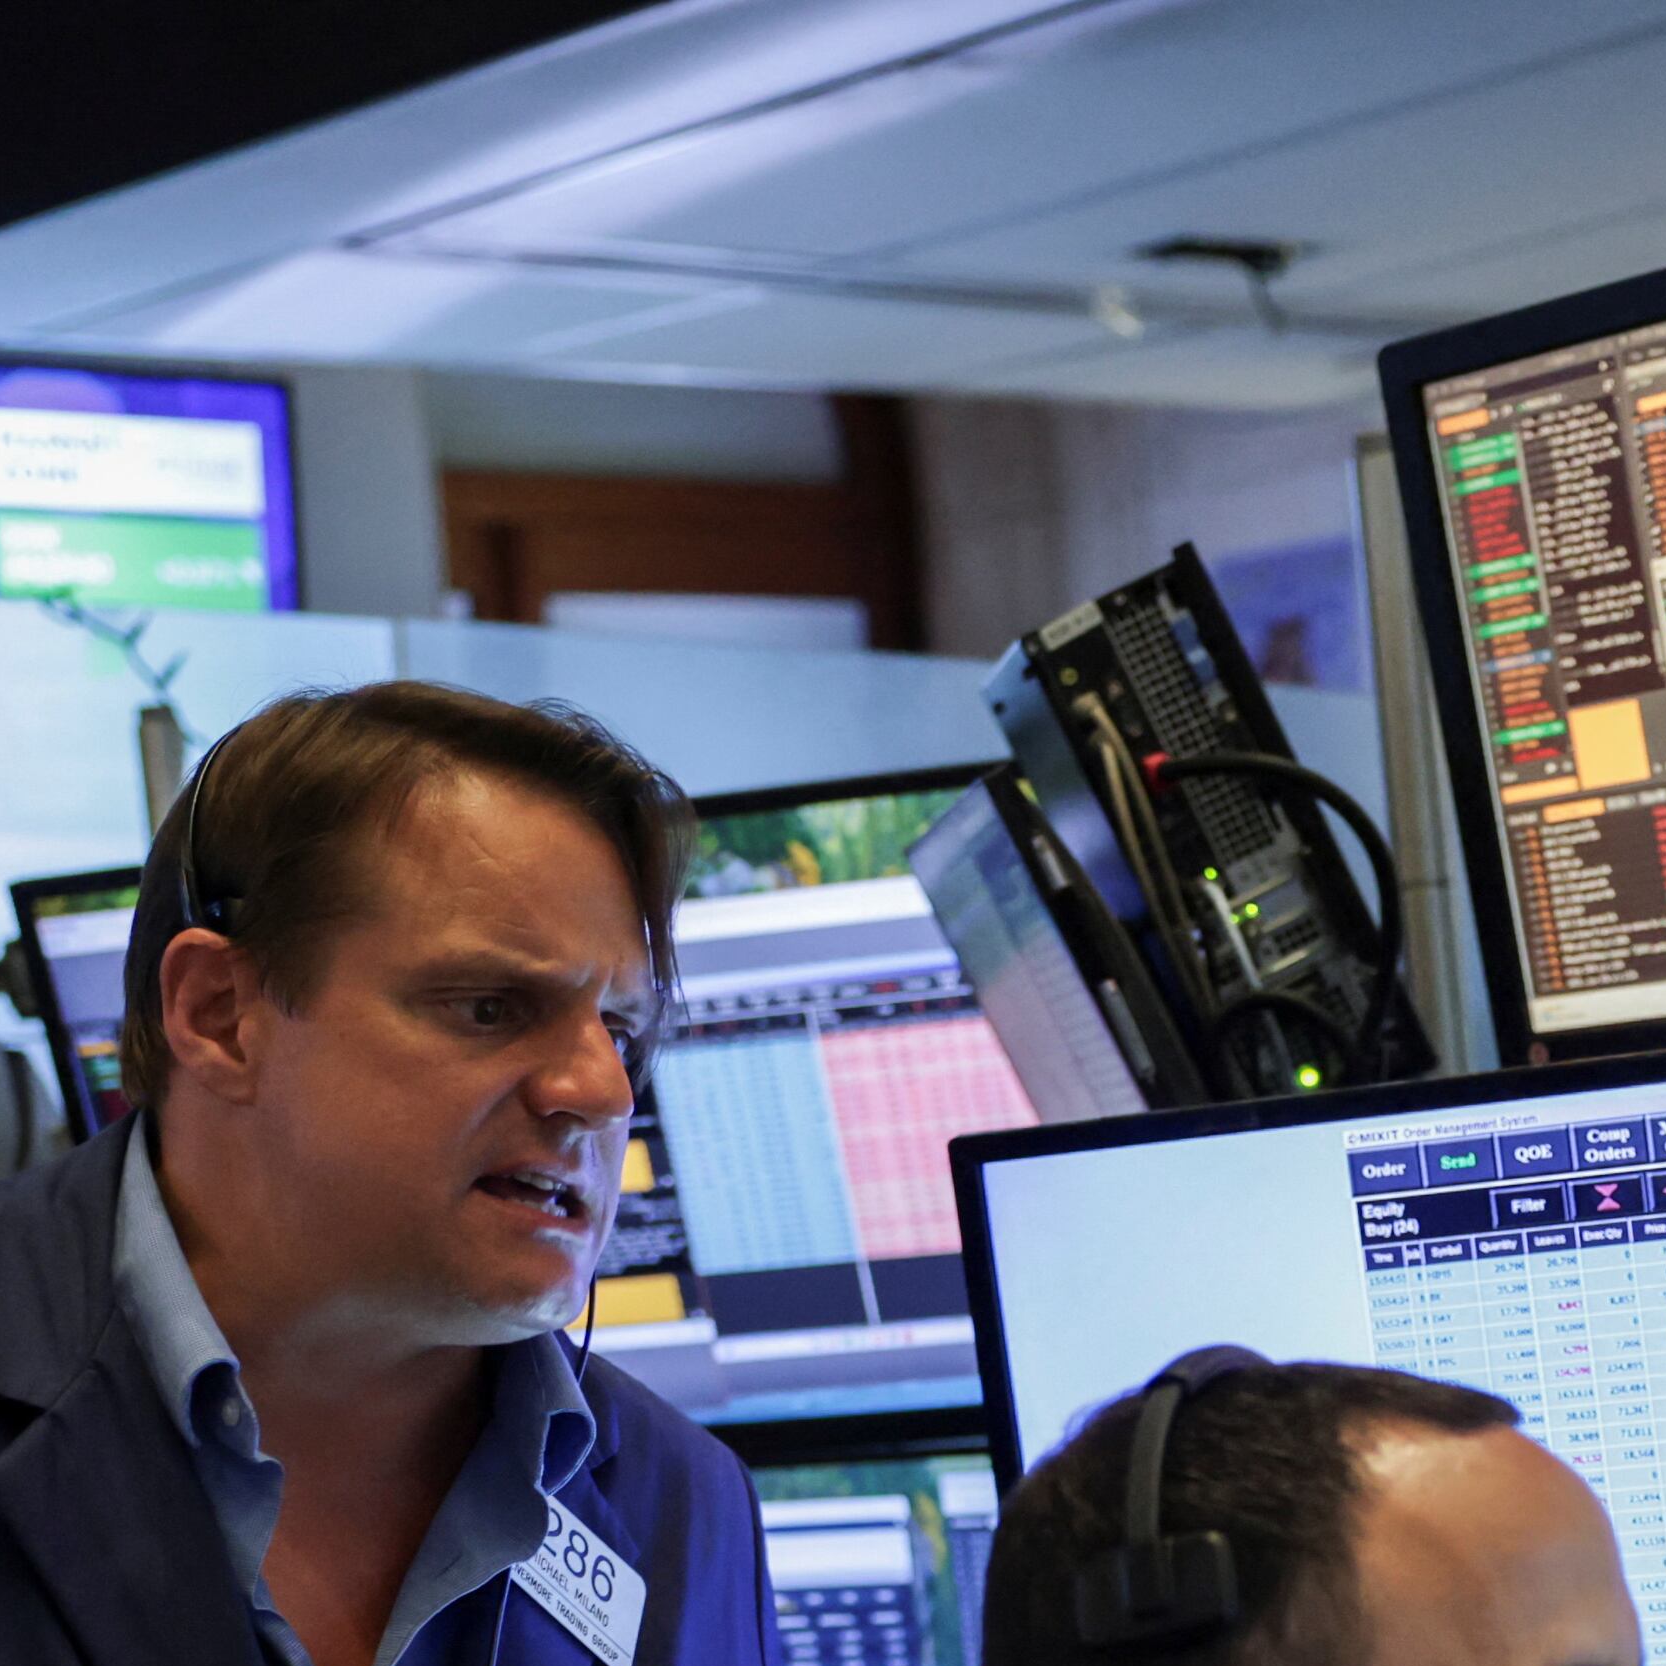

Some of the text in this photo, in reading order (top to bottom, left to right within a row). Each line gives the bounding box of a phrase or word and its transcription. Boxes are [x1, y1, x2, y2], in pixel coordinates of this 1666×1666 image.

[1586, 1126, 1630, 1146] Comp
[1440, 1152, 1477, 1170] Send
[1514, 1144, 1553, 1164] QOE
[1584, 1146, 1637, 1164] Orders
[1362, 1162, 1407, 1179] Order
[1363, 1202, 1405, 1220] Equity
[1510, 1198, 1546, 1214] Filter
[1364, 1218, 1420, 1238] Buy (24)
[514, 1564, 552, 1605] IVERMORE
[556, 1600, 588, 1636] TRADING
[574, 1588, 609, 1627] MILANO
